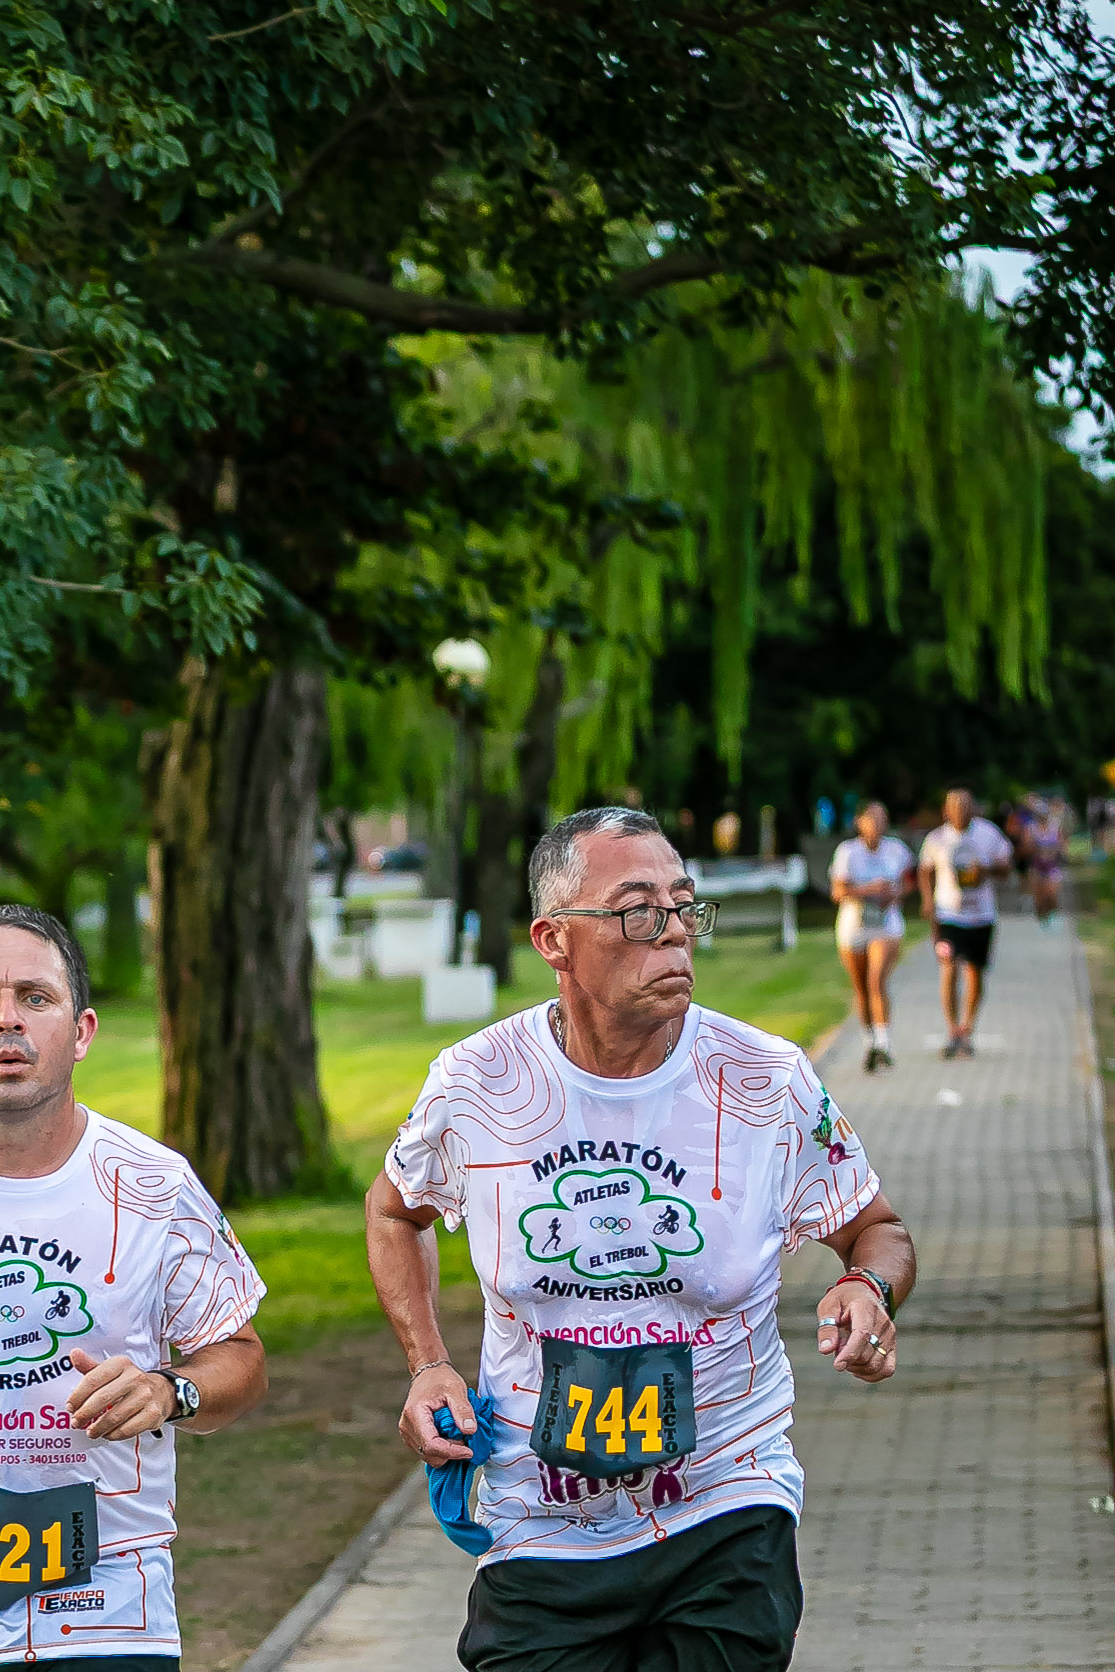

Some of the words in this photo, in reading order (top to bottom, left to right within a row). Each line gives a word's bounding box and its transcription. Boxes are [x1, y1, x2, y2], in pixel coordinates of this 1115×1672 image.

[531, 1140, 687, 1188] MARATÓN
[573, 1180, 631, 1206] ATLETAS
[589, 1256, 604, 1268] EL
[605, 1245, 649, 1264] TREBOL
[532, 1275, 684, 1301] ANIVERSARIO
[1, 1331, 42, 1350] TREBOL
[540, 1362, 563, 1443] TIEMPO
[661, 1372, 679, 1453] EXACTO
[565, 1384, 663, 1453] 744
[8, 1437, 72, 1449] SEGUROS
[29, 1453, 87, 1464] 3401516109
[34, 1589, 105, 1610] TIEMPO
[46, 1597, 105, 1611] EXACTO
